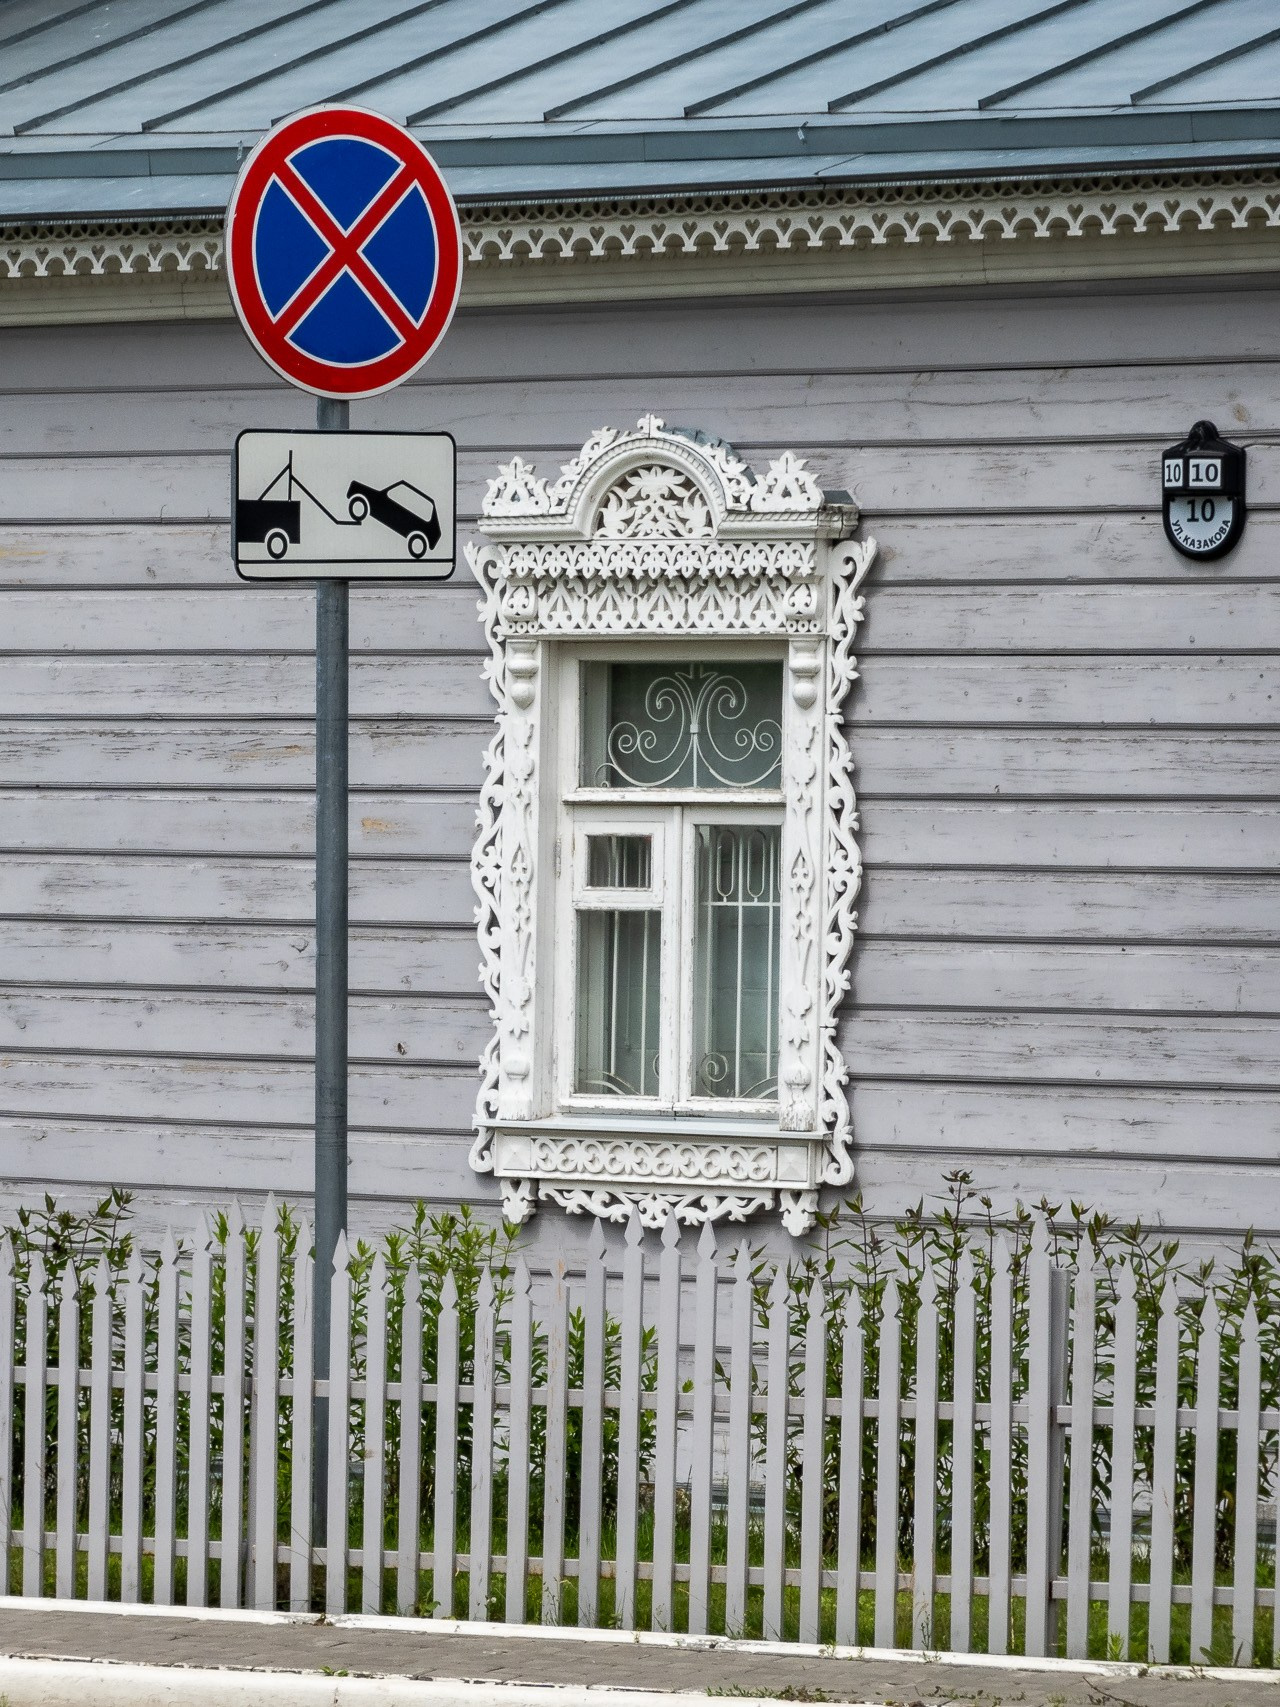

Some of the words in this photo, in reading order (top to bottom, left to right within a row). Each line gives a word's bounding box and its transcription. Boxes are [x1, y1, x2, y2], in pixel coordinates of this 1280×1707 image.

[1165, 463, 1181, 483] 10
[1191, 463, 1219, 483] 10
[1186, 498, 1216, 522] 10
[1171, 519, 1184, 540] УЛ.
[1182, 519, 1231, 550] КАЗАКОВА
